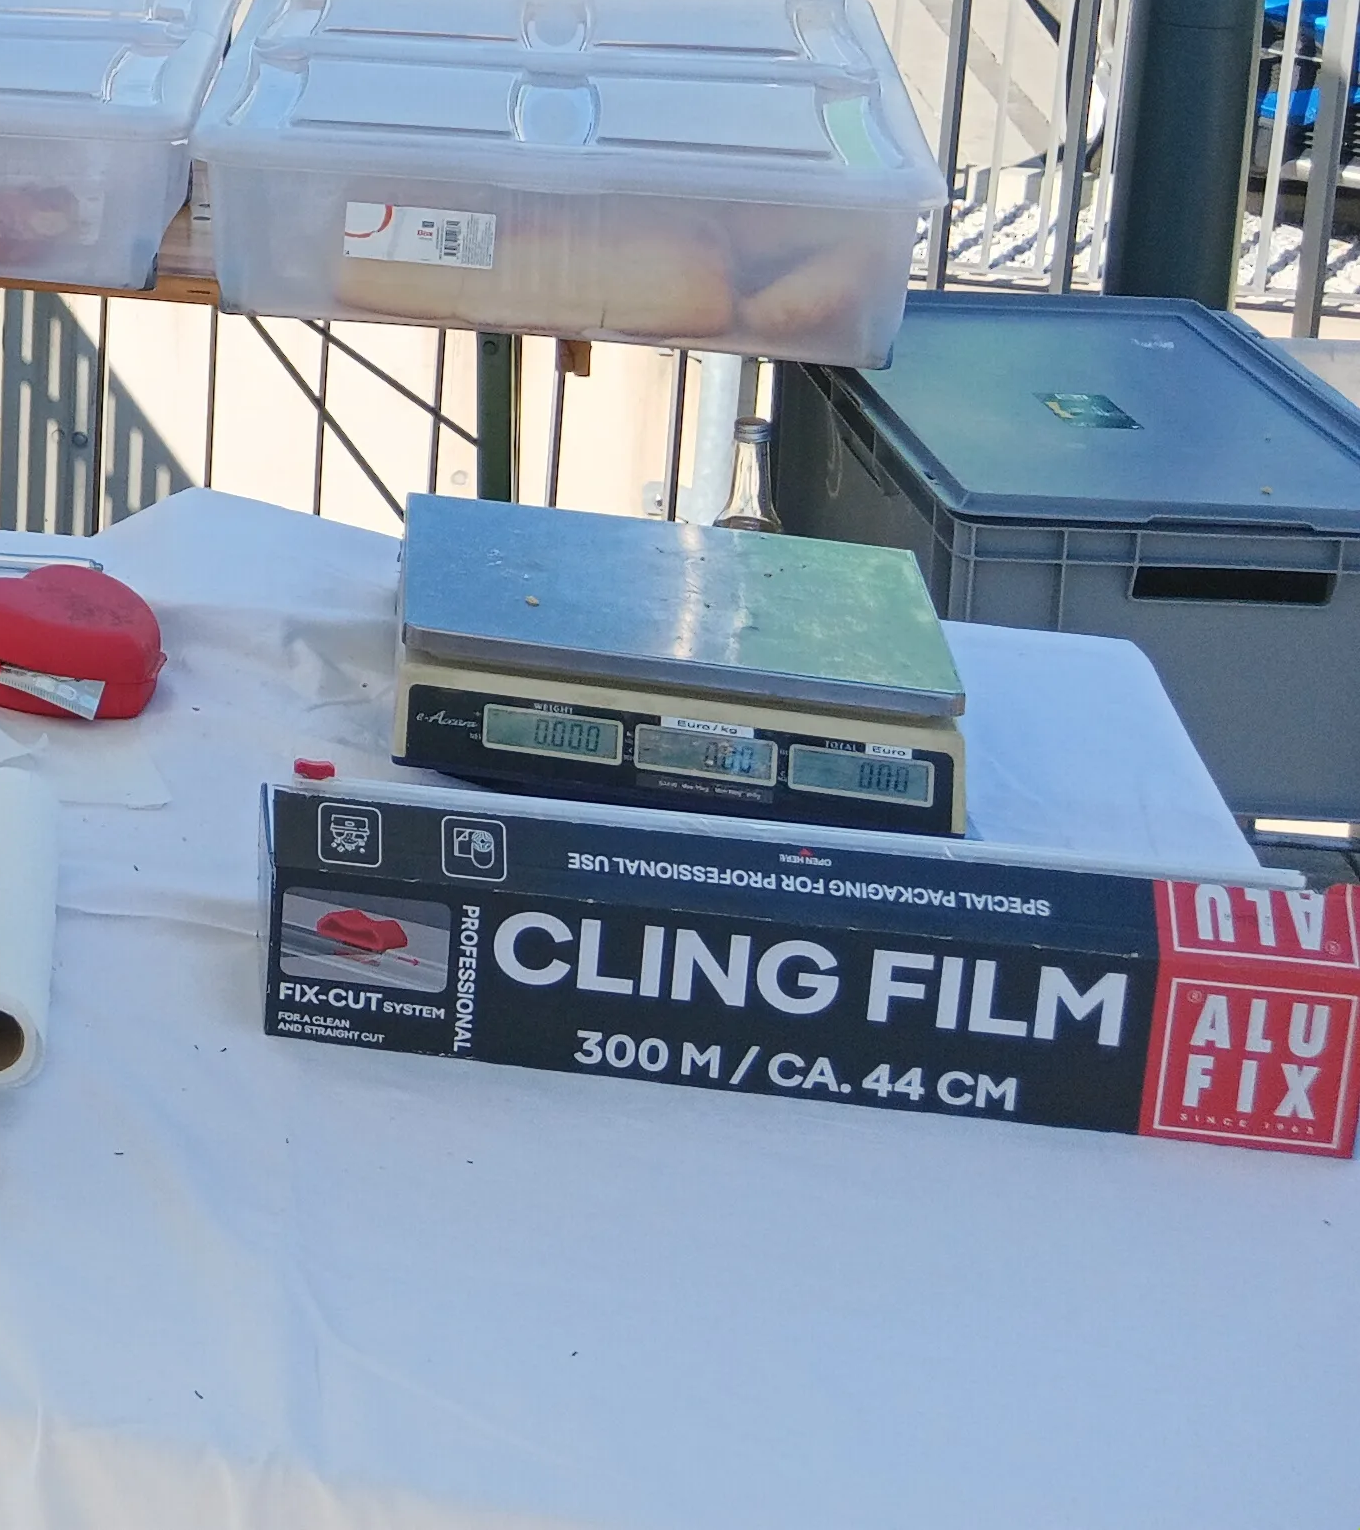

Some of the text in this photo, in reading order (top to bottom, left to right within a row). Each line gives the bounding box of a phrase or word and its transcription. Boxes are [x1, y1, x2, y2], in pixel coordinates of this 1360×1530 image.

[533, 702, 574, 715] WEIGHT
[677, 719, 711, 731] Euro
[824, 740, 858, 753] TOTAL
[871, 745, 907, 757] Euro
[567, 852, 1052, 918] SPECIAL PACKAGING FOR PROFESSIONAL USE
[1194, 883, 1326, 951] ALU
[453, 904, 481, 1053] PROFESSIONAL
[493, 911, 1129, 1047] CLING FILM
[277, 1011, 350, 1029] FOR A CLEAN
[278, 981, 446, 1020] FIX-CUT SYSTEM
[277, 1022, 386, 1044] AND STRAIGHT CUT
[1189, 993, 1331, 1059] ALU
[574, 1029, 1019, 1112] 300 M / CA. 44 CM
[1182, 1054, 1323, 1120] FIX
[1179, 1112, 1248, 1129] SINCE
